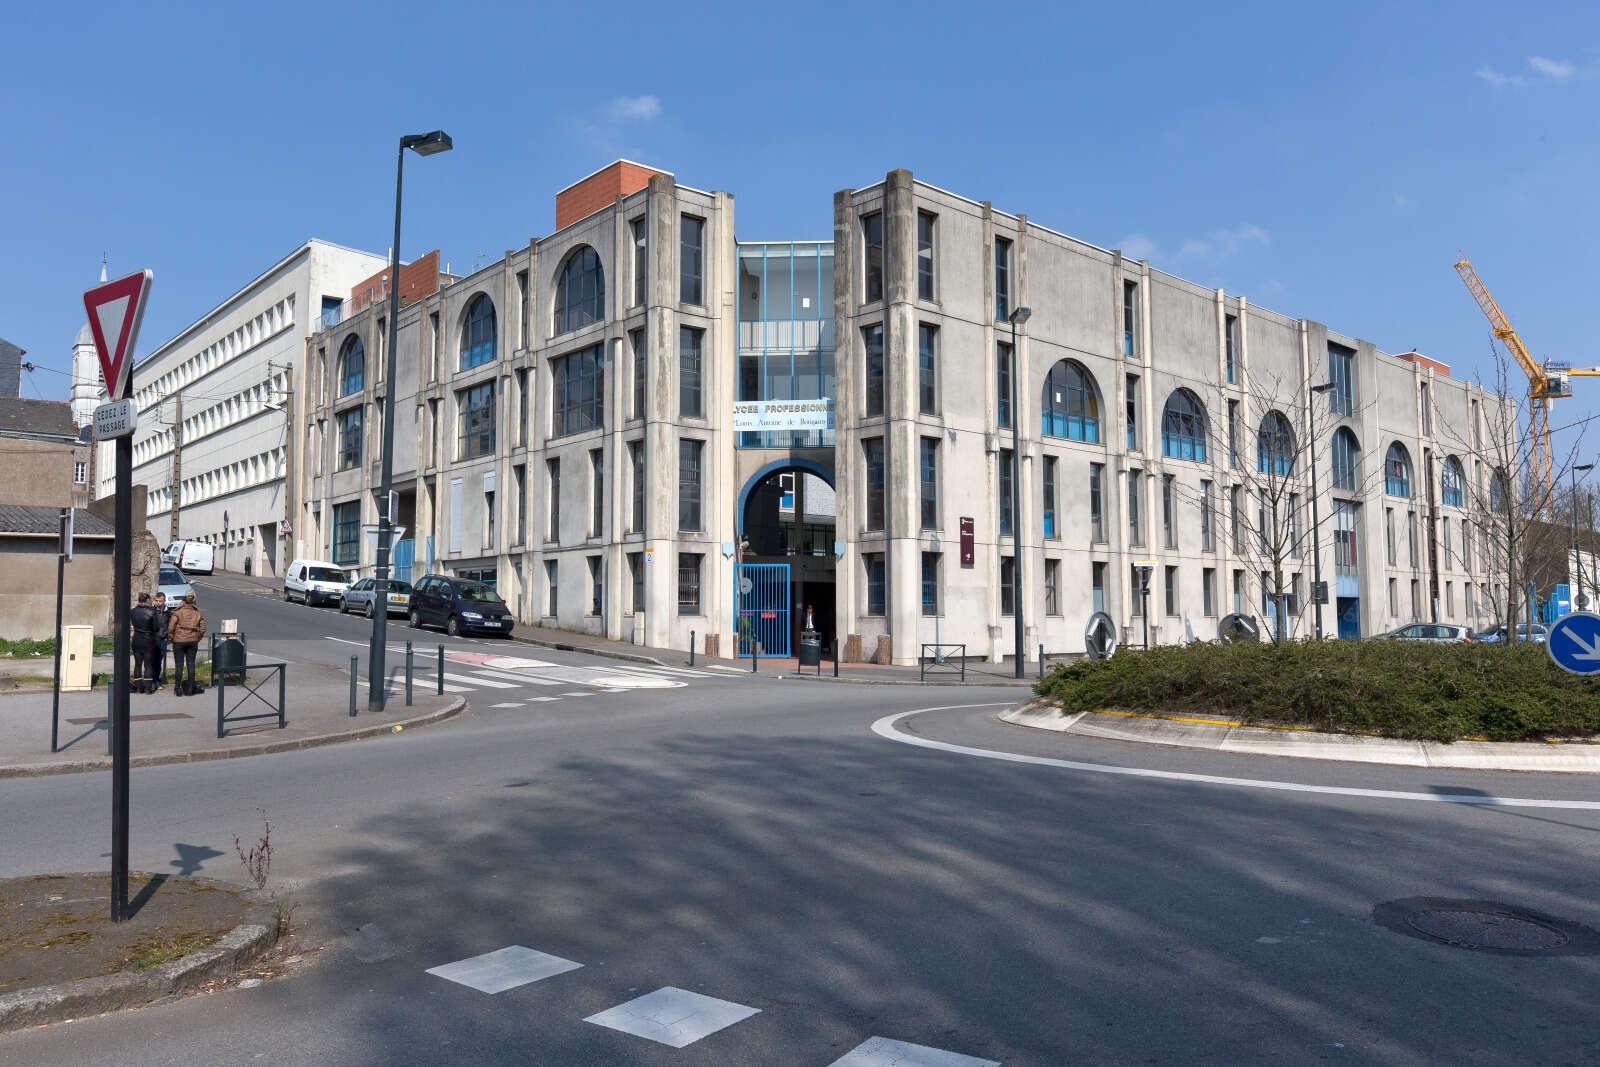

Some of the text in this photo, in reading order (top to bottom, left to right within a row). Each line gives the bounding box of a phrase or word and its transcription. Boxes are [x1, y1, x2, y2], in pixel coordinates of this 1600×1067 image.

[120, 404, 127, 416] LE
[765, 403, 833, 413] PROFESSIONNE
[99, 419, 126, 433] PASSAGE
